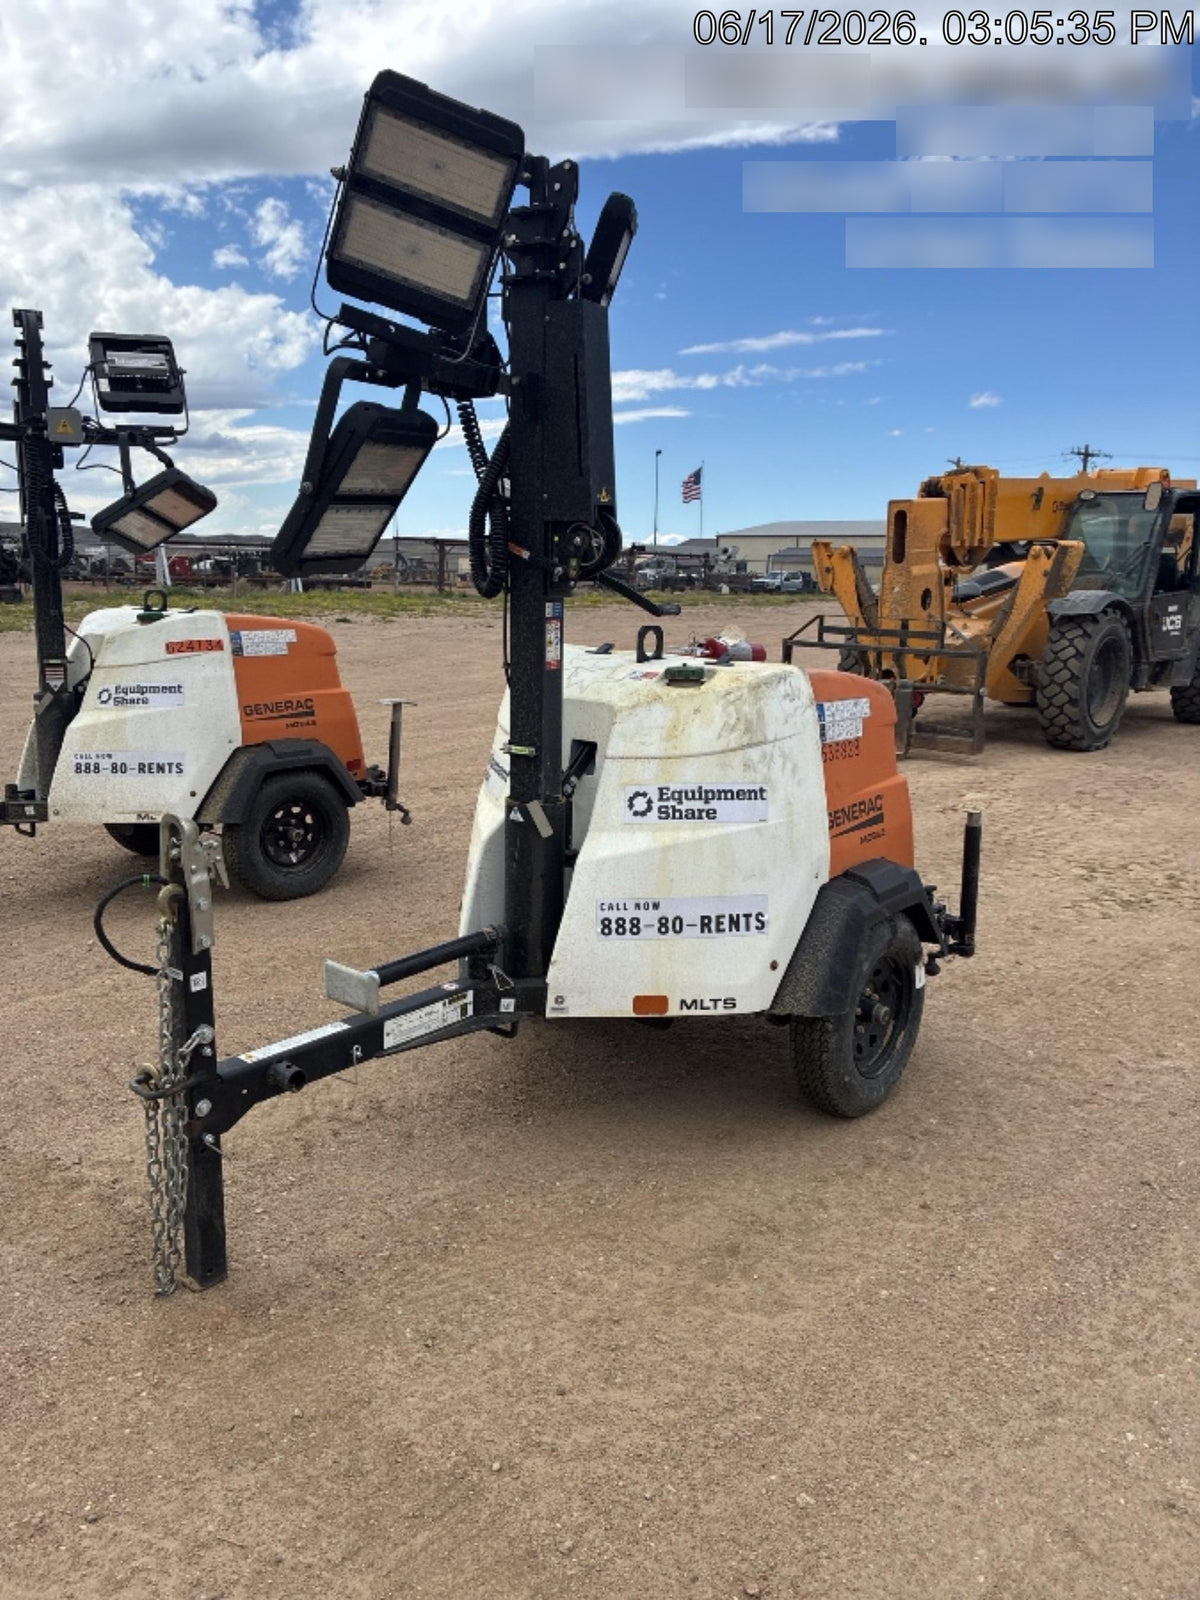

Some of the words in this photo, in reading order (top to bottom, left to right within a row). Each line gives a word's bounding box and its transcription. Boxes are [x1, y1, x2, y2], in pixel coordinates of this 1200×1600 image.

[114, 684, 183, 696] Equipment
[113, 697, 149, 706] Share
[243, 698, 314, 717] GENERAC
[74, 762, 184, 774] 888-80-RENTS
[657, 785, 768, 805] Equipment
[657, 805, 717, 820] Share
[600, 902, 629, 911] CALL
[634, 901, 660, 911] NOW
[600, 912, 766, 936] 888-80-RENTS
[680, 998, 737, 1010] MLTS
